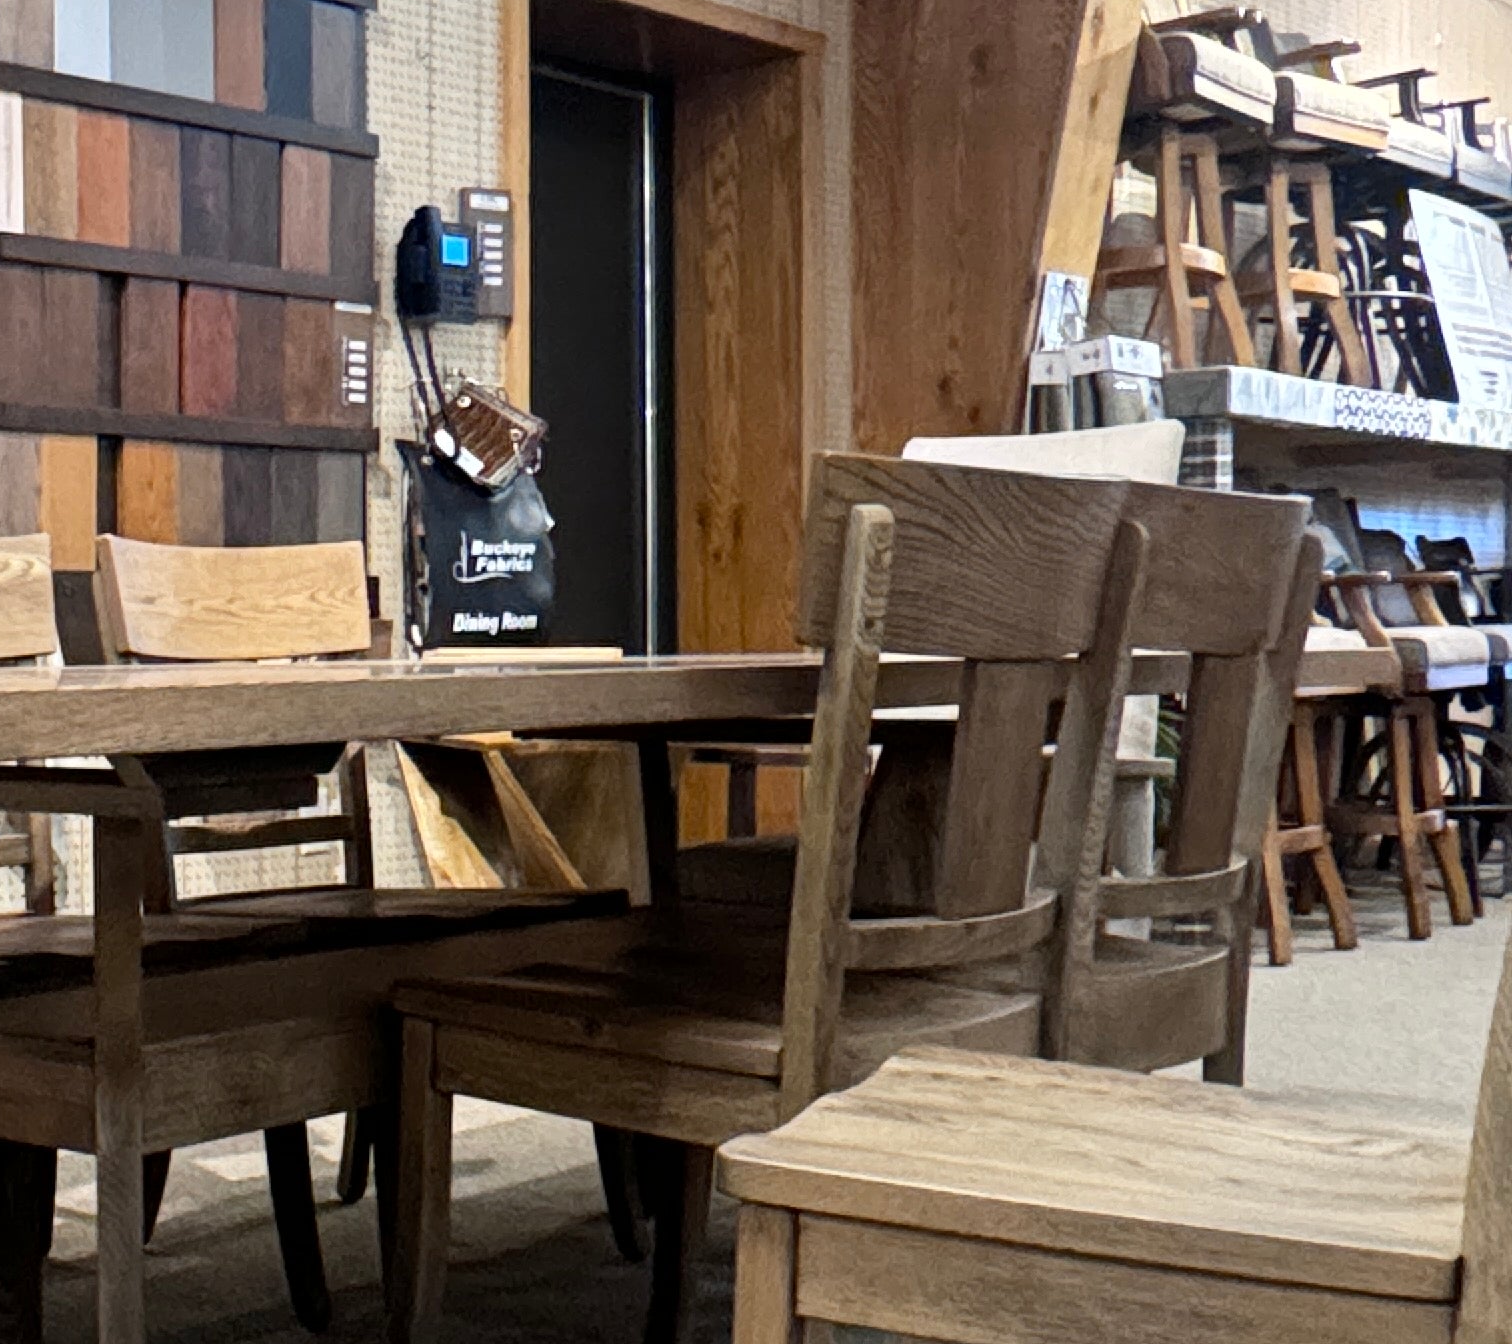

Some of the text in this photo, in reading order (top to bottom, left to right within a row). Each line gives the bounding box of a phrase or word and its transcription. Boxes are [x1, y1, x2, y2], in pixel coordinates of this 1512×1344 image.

[470, 538, 537, 559] Buckeye
[475, 555, 534, 572] Fabrics
[452, 609, 538, 637] Dining Room
